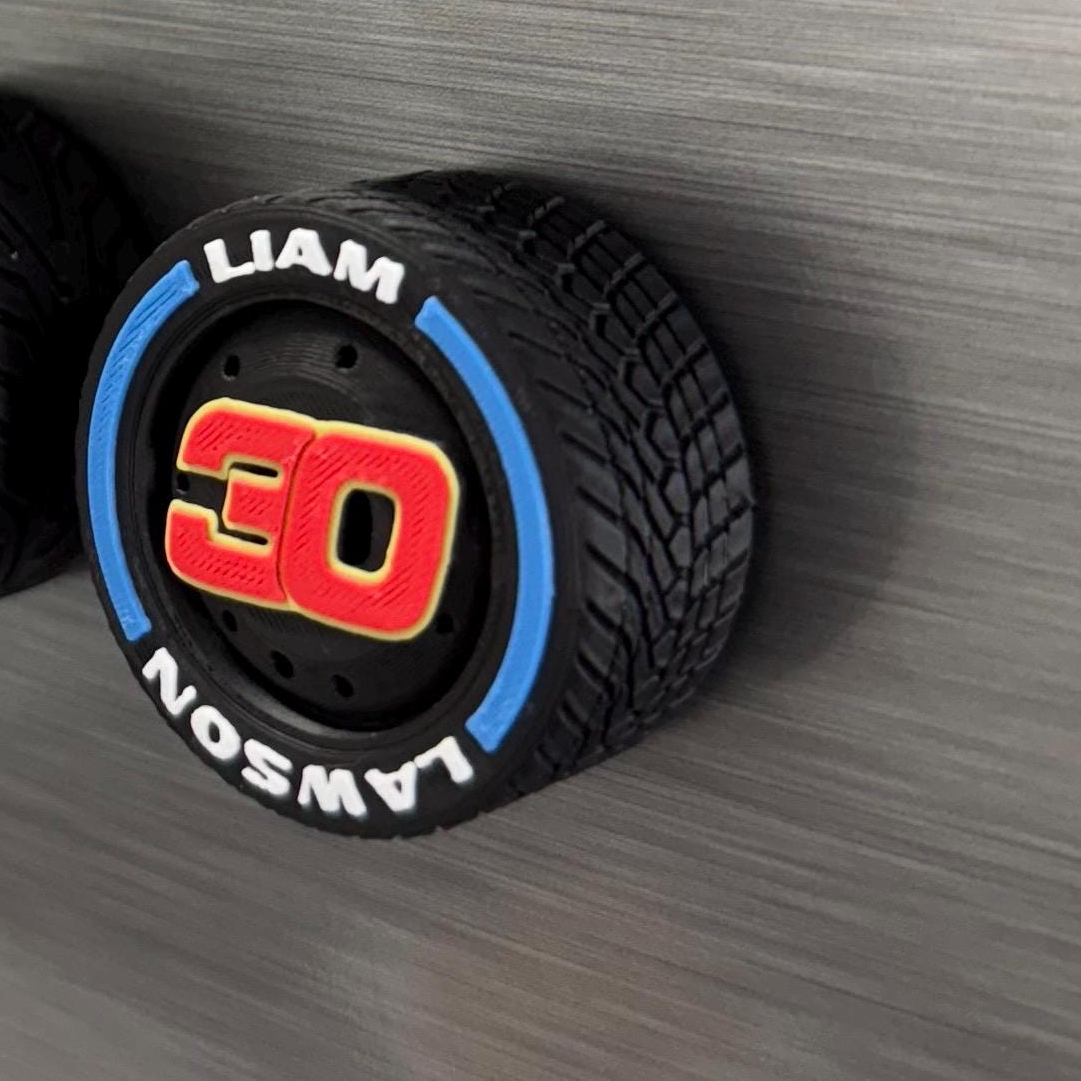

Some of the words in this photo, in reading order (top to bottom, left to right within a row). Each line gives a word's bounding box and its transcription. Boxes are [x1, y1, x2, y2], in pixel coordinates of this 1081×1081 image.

[203, 227, 405, 304] LIAM
[164, 396, 462, 642] 30
[141, 646, 474, 817] LAWSON
